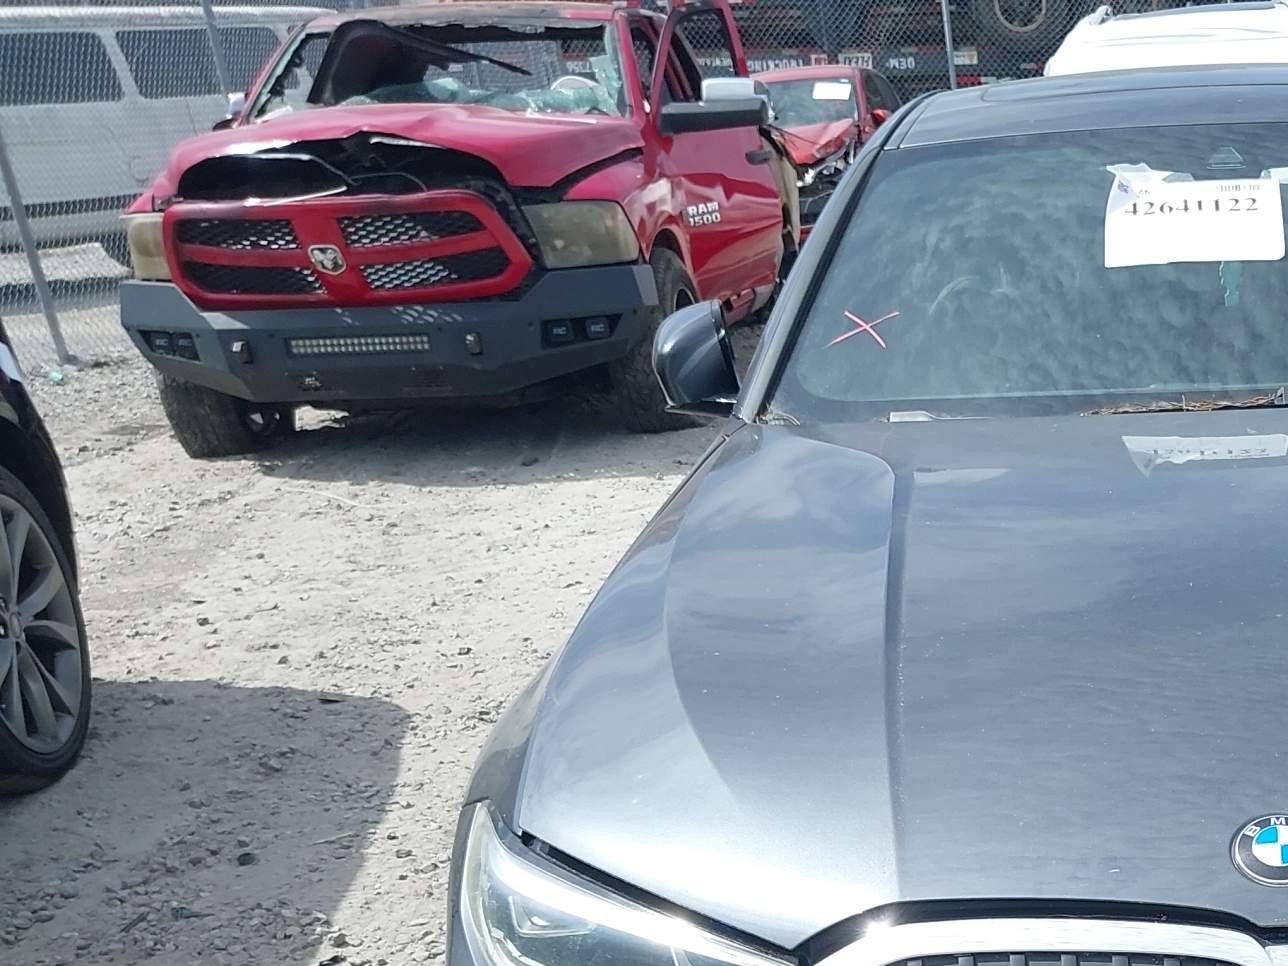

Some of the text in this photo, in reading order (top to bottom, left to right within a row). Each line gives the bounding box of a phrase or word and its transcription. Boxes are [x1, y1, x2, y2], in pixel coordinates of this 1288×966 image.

[687, 202, 719, 215] RAM
[1125, 198, 1258, 215] 42641122
[688, 212, 721, 227] 1500
